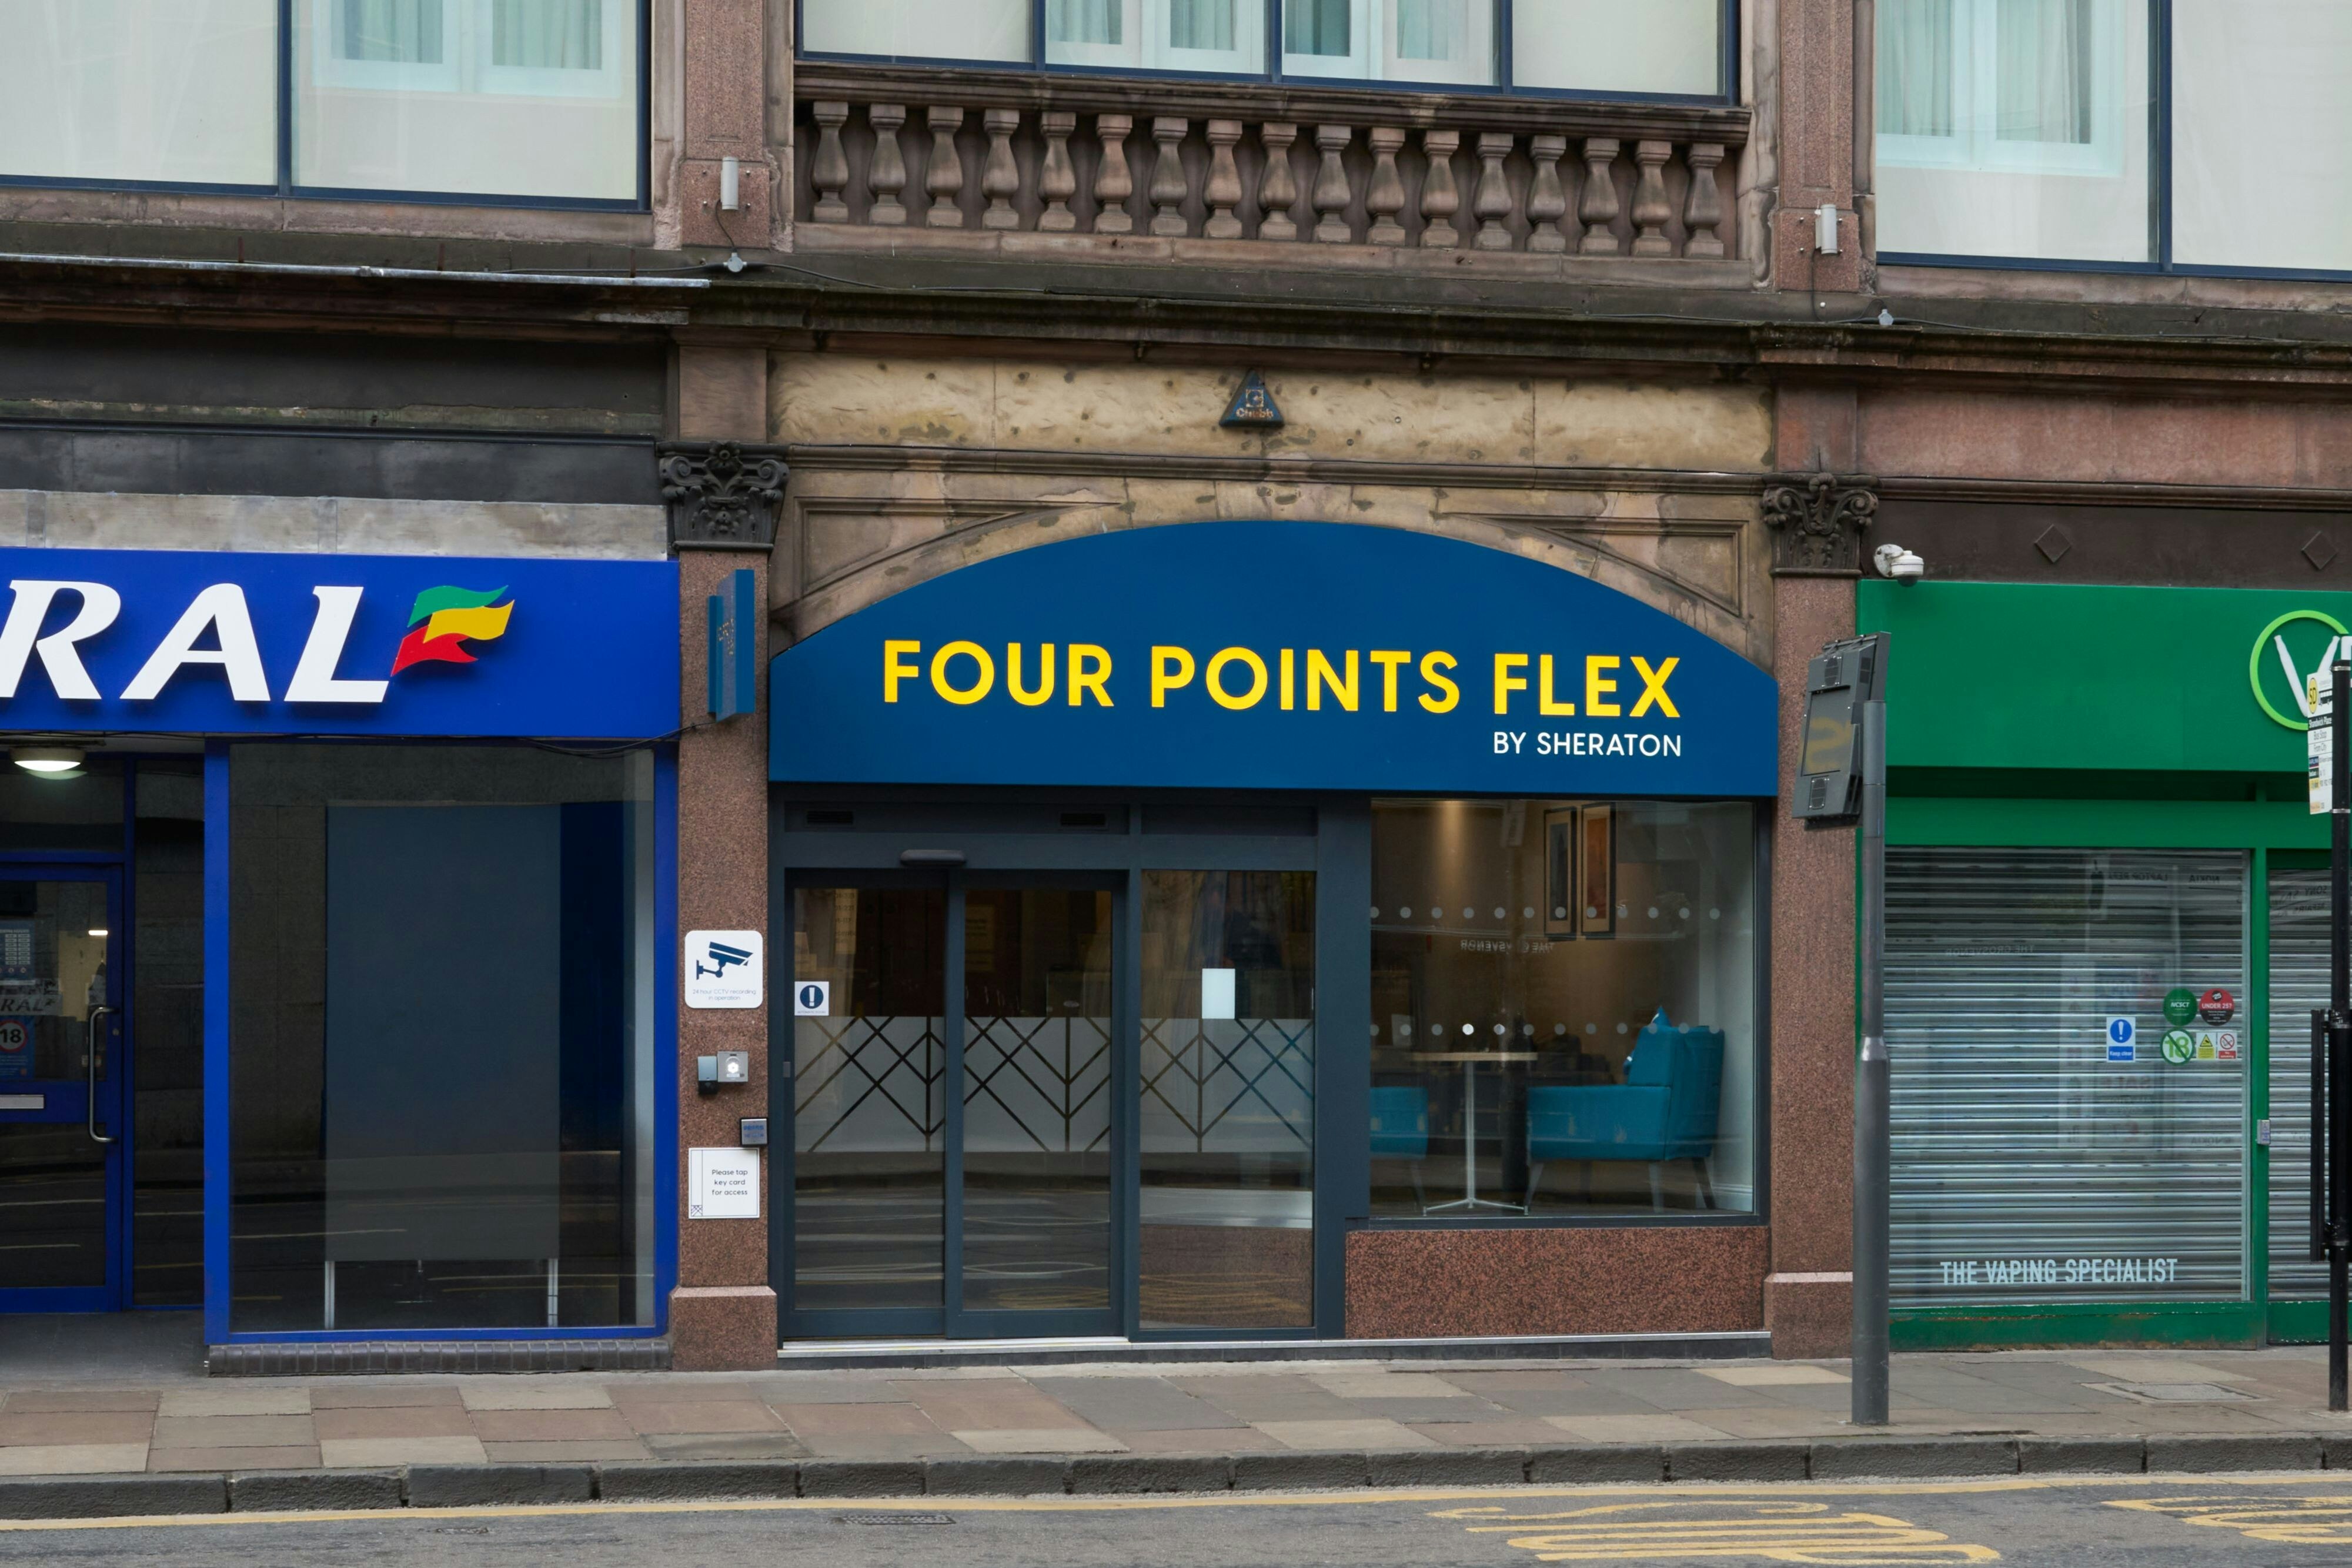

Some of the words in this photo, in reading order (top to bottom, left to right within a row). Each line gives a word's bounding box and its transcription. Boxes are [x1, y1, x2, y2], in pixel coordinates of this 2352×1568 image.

[884, 640, 1114, 707] FOUR
[1151, 646, 1460, 714] POINTS
[1494, 653, 1681, 718] FLEX
[1494, 731, 1526, 754] BY
[1537, 732, 1681, 757] SHERATON
[0, 1029, 22, 1044] 18
[2164, 1036, 2190, 1058] 18
[1940, 1261, 1977, 1285] THE
[1985, 1259, 2057, 1285] VAPING
[2065, 1258, 2178, 1283] SPECIALIST
[1426, 1500, 2003, 1565] STOP
